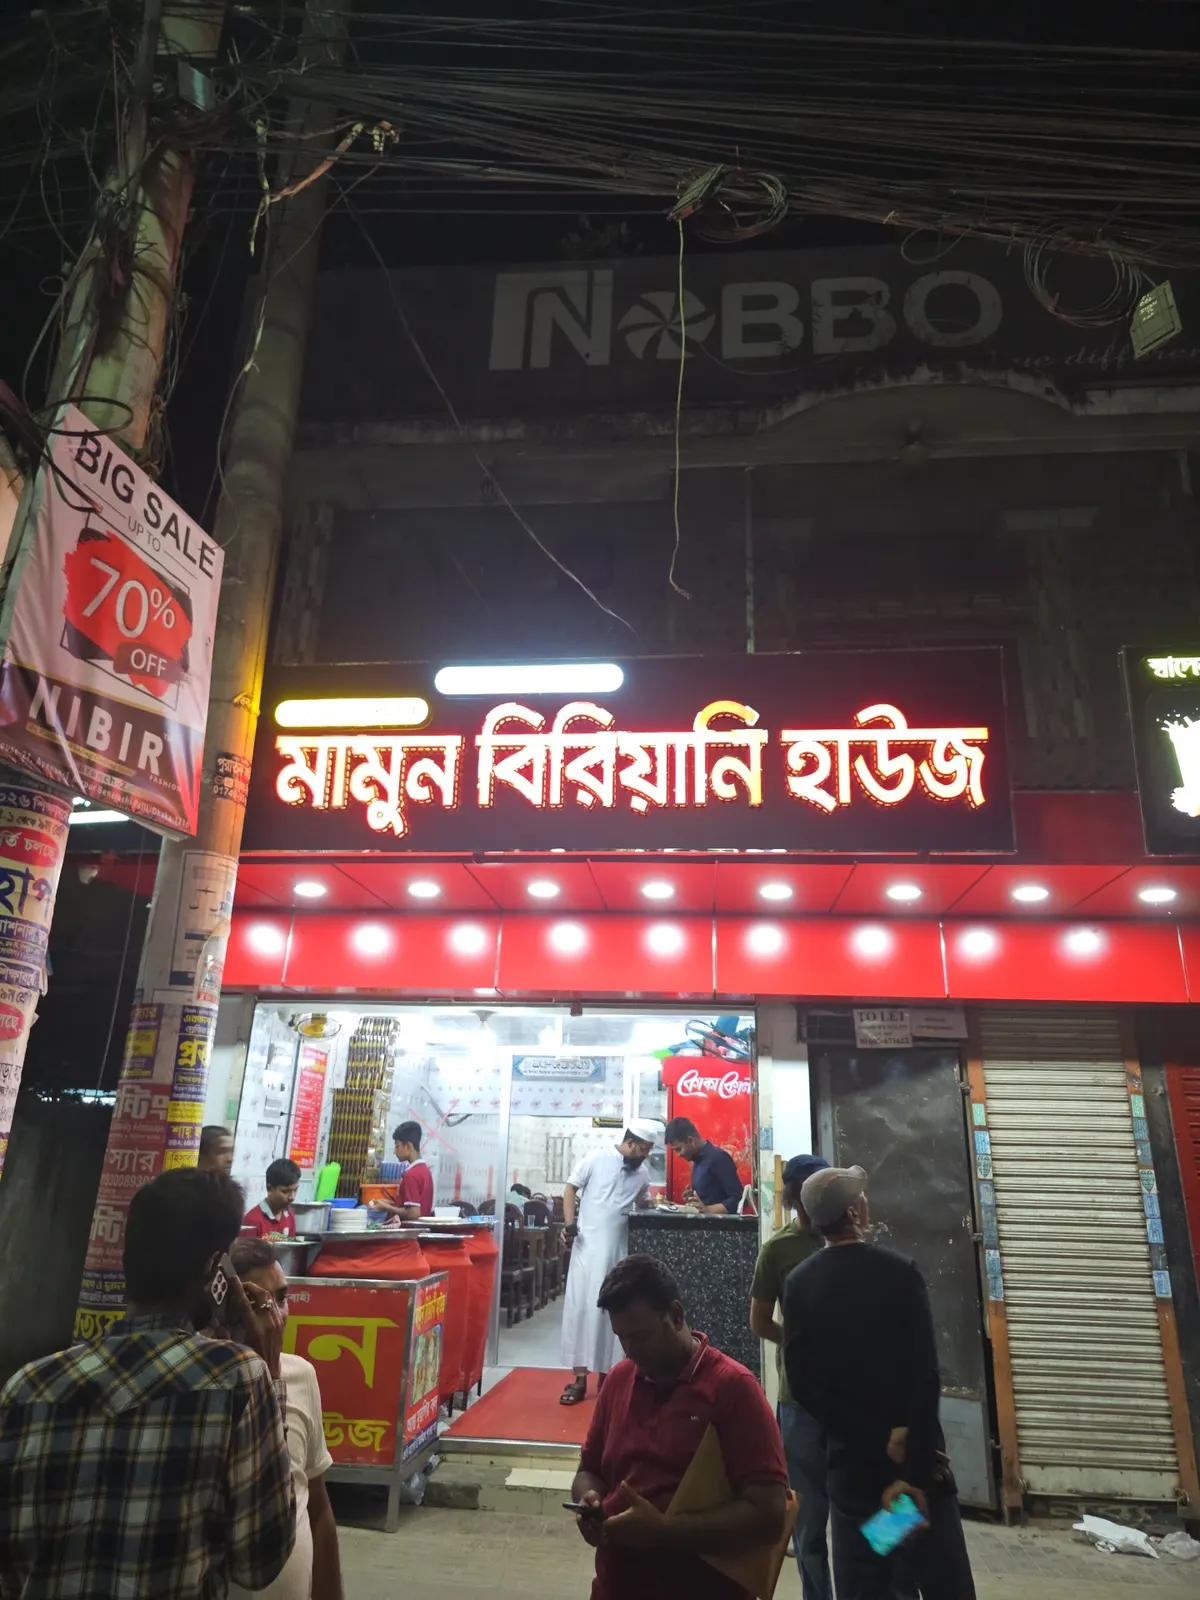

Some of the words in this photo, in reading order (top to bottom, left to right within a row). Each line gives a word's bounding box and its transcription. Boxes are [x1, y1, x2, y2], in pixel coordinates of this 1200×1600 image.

[75, 429, 136, 505] BIG
[143, 491, 216, 580] SALE
[127, 517, 144, 536] UP
[145, 528, 162, 553] TO
[82, 556, 176, 639] 70%
[130, 648, 168, 678] OFF
[28, 672, 164, 776] NIBIR
[275, 734, 464, 837] মামুন
[475, 701, 769, 816] বিরিয়ানি
[779, 702, 989, 816] হাউজ
